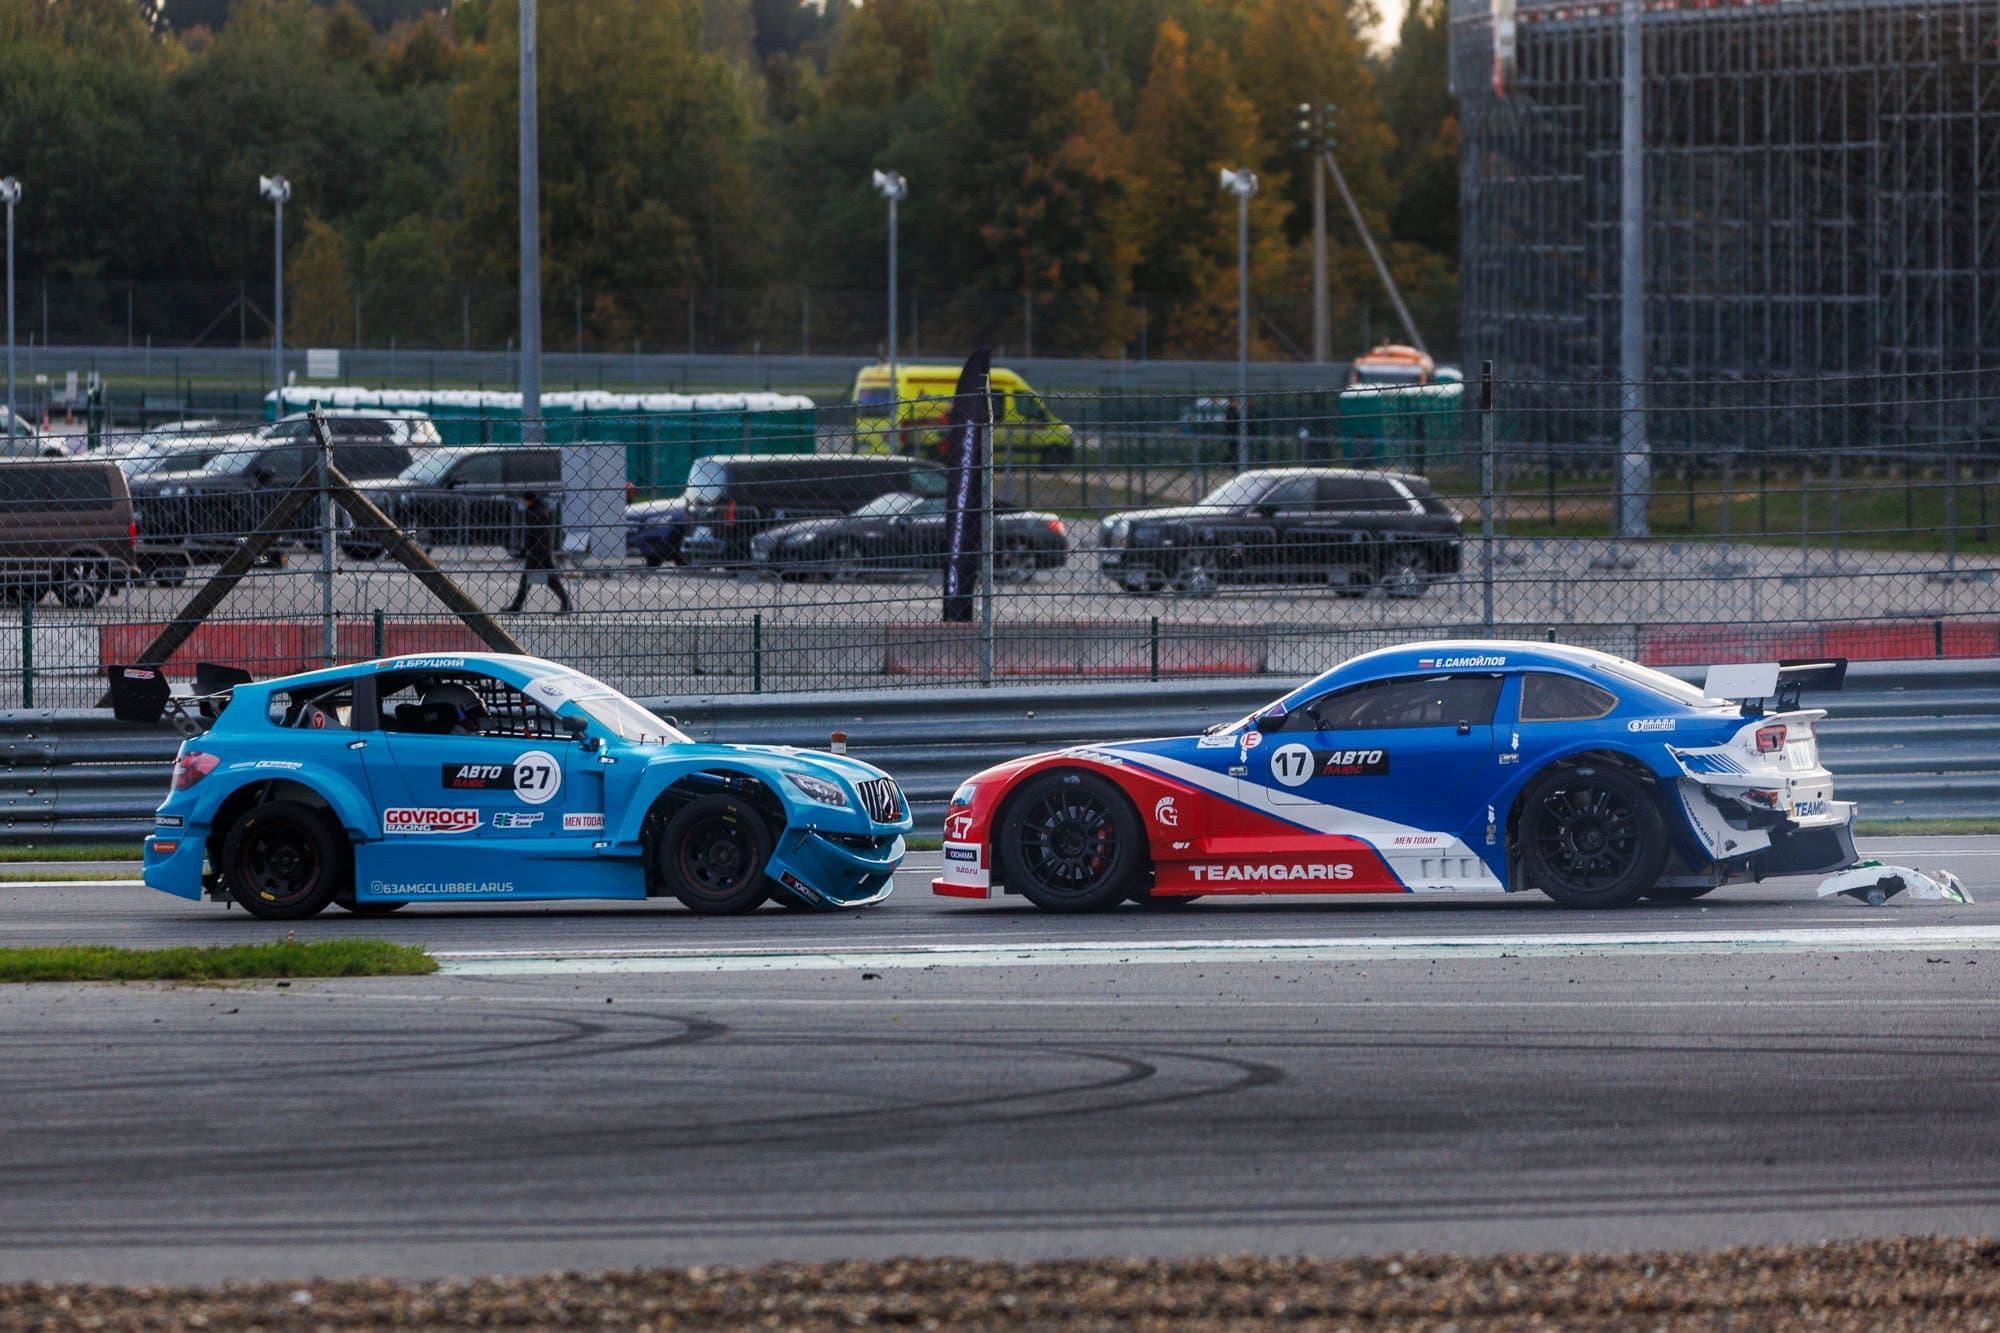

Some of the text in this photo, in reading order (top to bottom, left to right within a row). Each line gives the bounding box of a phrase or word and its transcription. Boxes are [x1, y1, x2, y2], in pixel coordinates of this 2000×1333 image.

[393, 657, 465, 669] Д.БРУЦКИЙ
[1435, 655, 1506, 668] Е.САМОЙЛОВ
[1326, 750, 1383, 765] АВТО
[1275, 752, 1307, 777] 17
[1322, 765, 1364, 775] ПЛЮС
[455, 765, 503, 779] АВТО
[519, 766, 551, 789] 27
[452, 779, 488, 788] ПЛЮС
[385, 810, 478, 825] GOVROCH
[565, 816, 582, 827] MEN
[385, 824, 432, 832] RACING
[952, 816, 973, 840] 17
[1394, 836, 1439, 845] MEN TODAY
[1188, 864, 1354, 881] TEAMGARIS
[383, 882, 514, 893] 63AMGCLUBBELARUS
